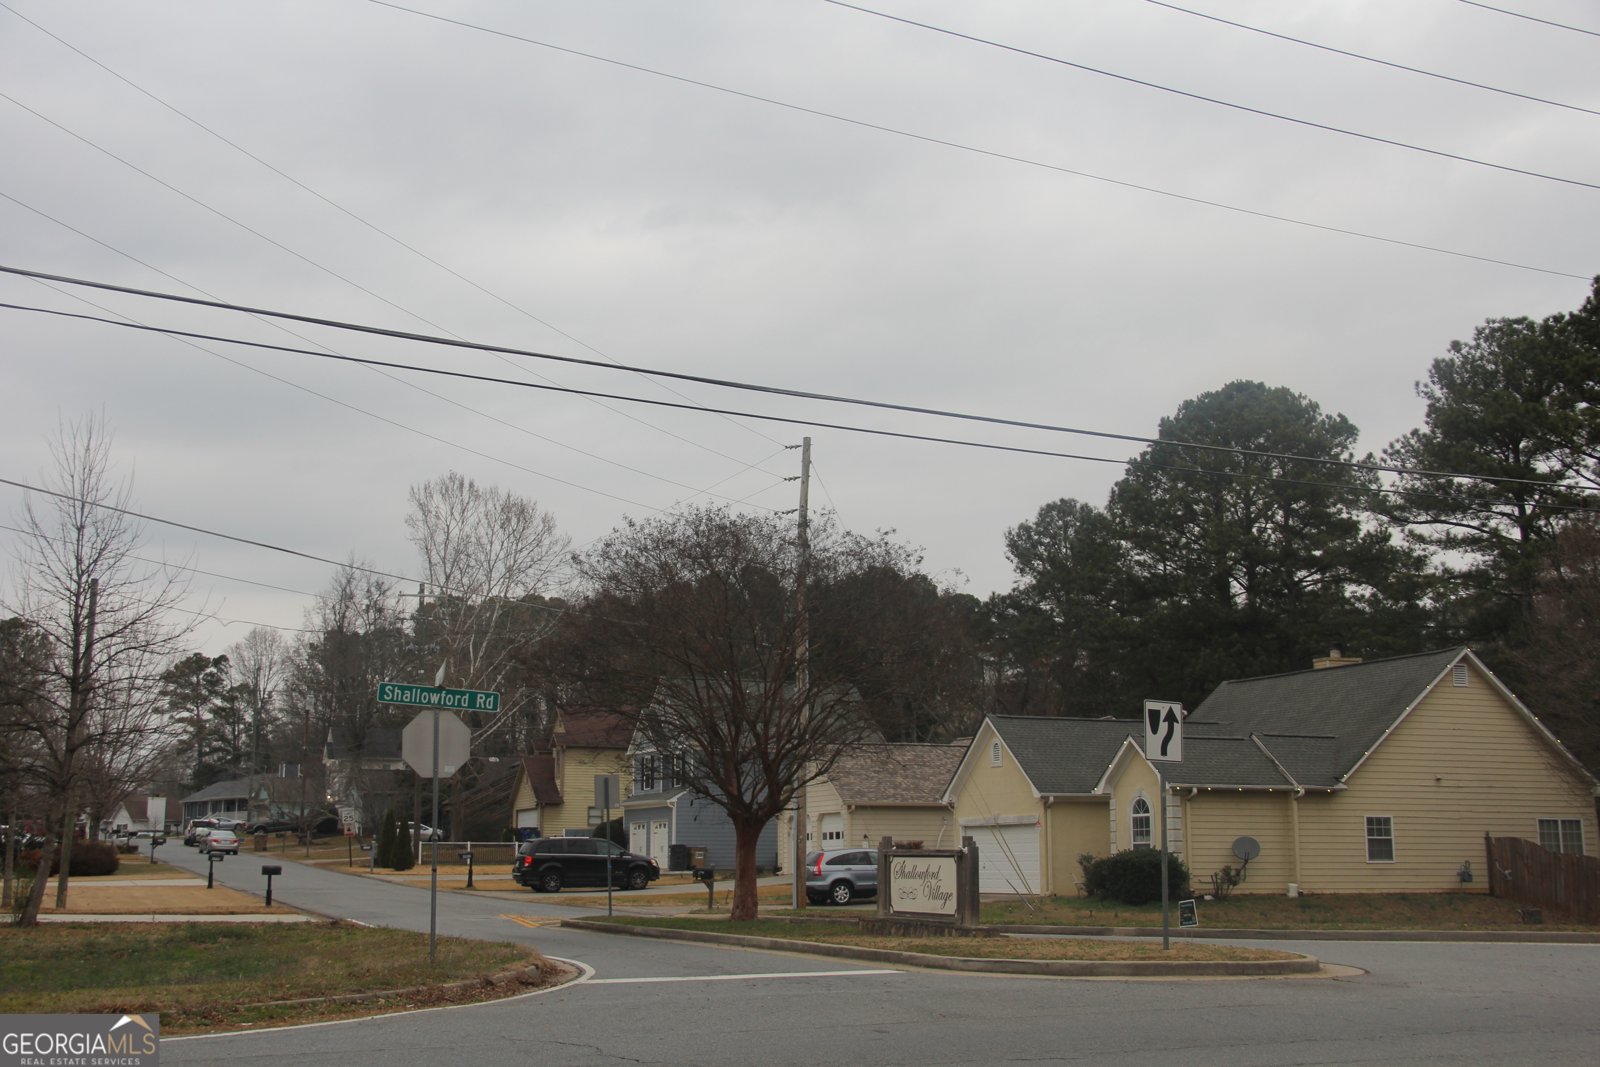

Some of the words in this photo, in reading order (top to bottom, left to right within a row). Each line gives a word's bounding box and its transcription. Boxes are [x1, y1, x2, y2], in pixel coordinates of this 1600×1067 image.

[384, 685, 469, 707] Shallowford
[476, 693, 494, 709] Rd
[893, 860, 942, 886] Shallowford
[922, 879, 954, 911] Village
